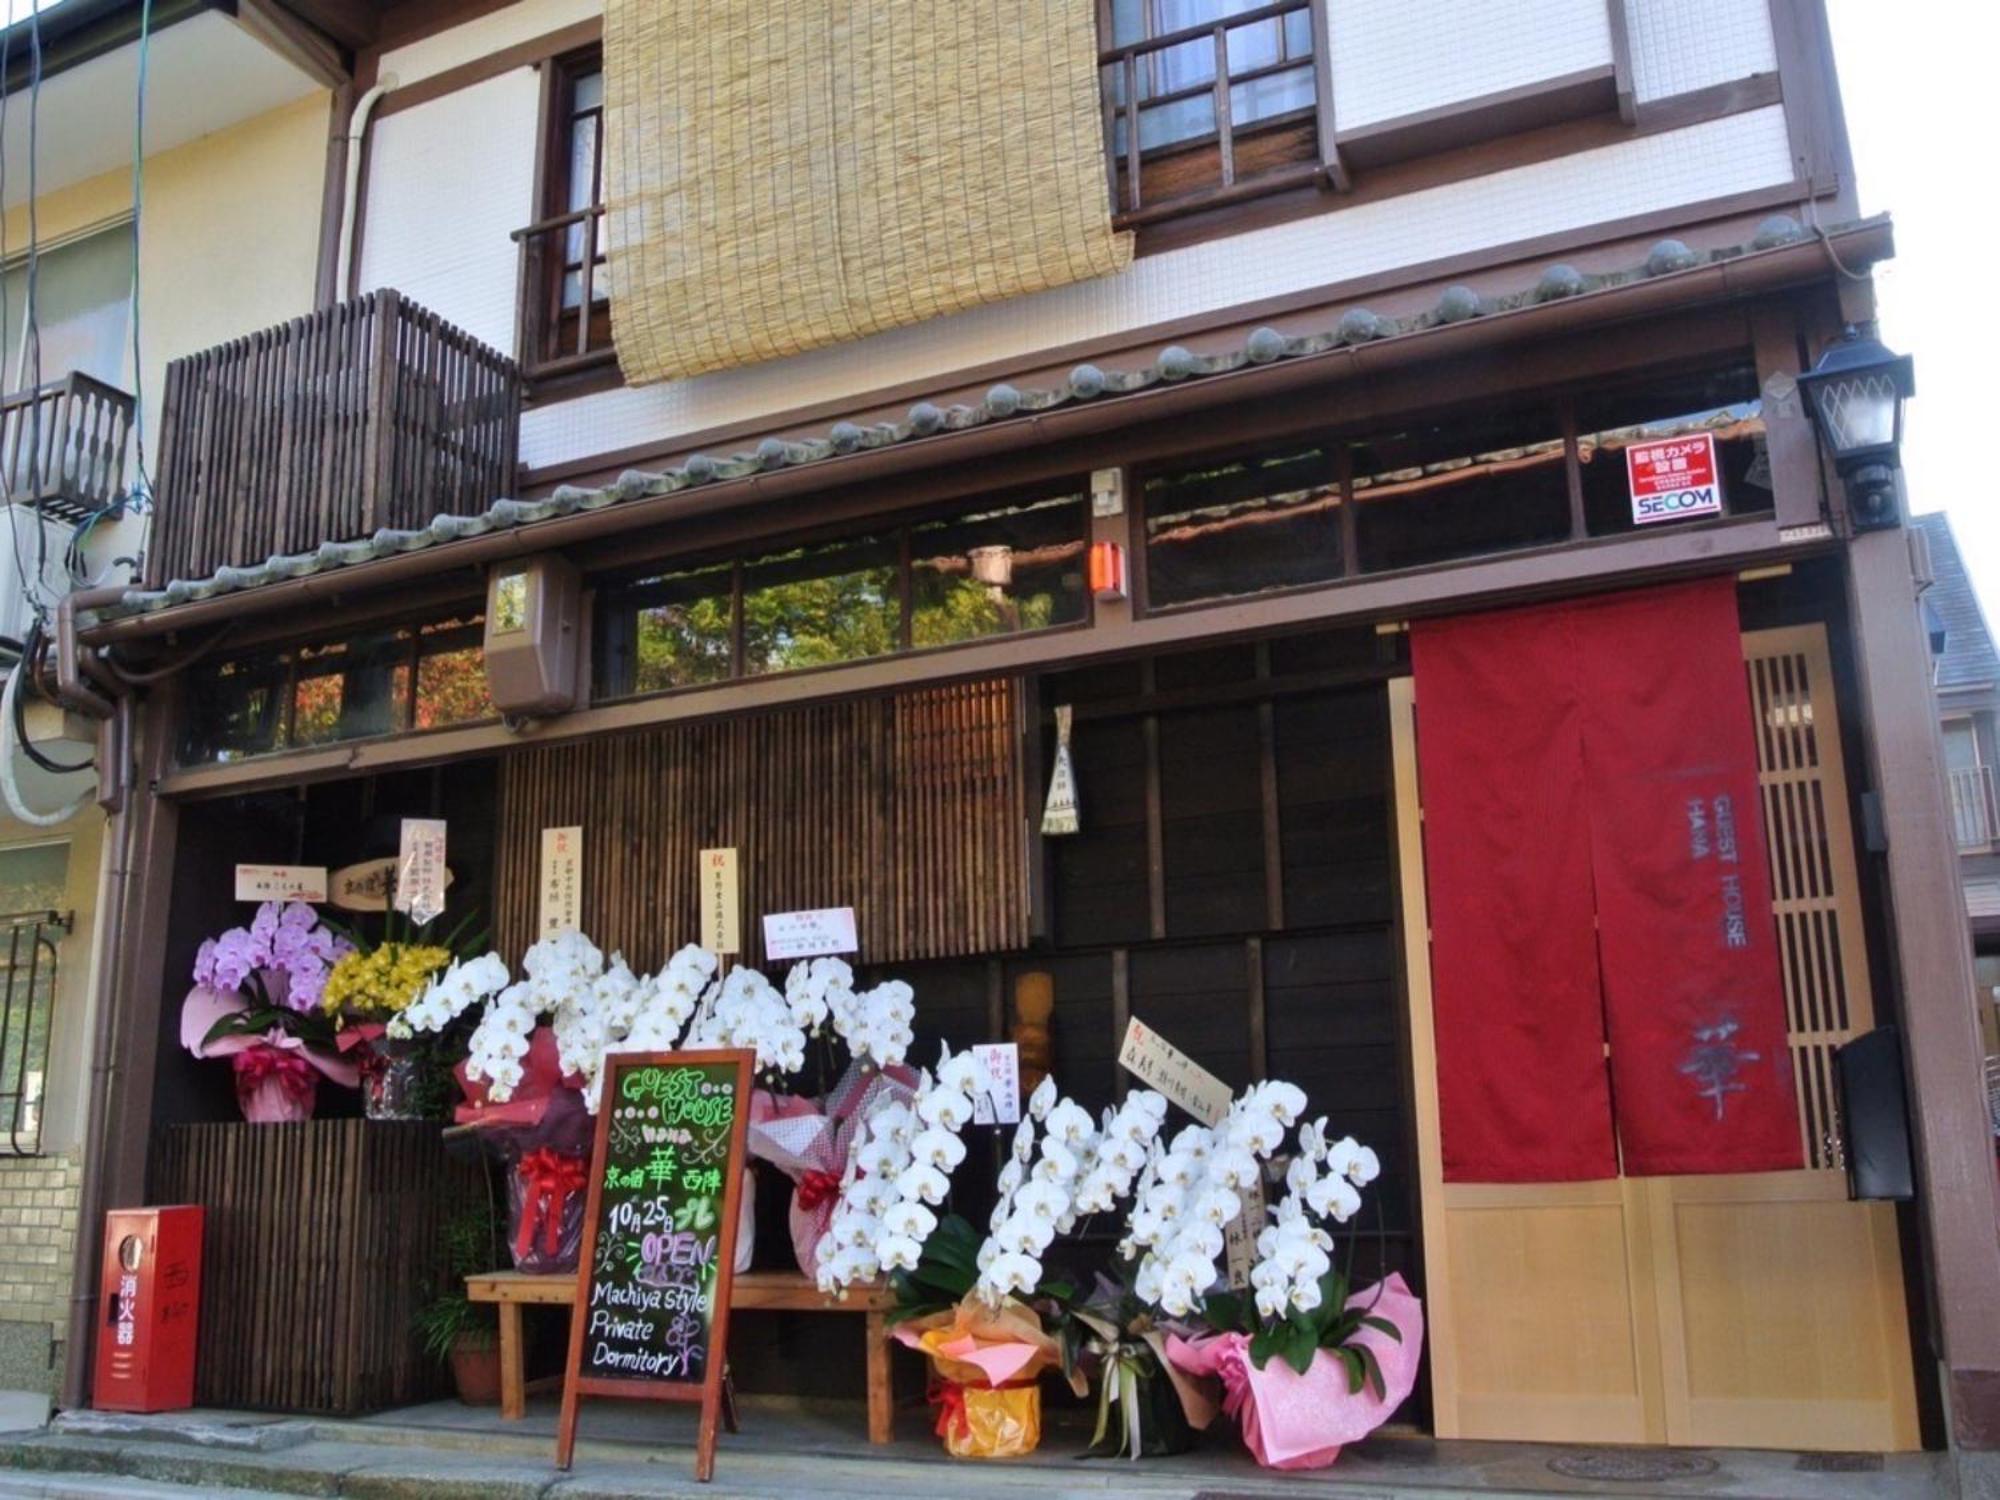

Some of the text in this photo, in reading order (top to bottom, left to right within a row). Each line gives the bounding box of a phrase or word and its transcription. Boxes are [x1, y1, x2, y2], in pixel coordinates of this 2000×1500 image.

[1638, 488, 1713, 514] SECOM
[1688, 799, 1710, 859] HANA
[1713, 798, 1746, 947] GUEST HOUSE
[623, 1068, 705, 1101] GUEST
[662, 1097, 734, 1126] HOUSE
[646, 1146, 678, 1191] 華
[682, 1168, 722, 1195] 西陣
[641, 1232, 716, 1266] OPEN
[117, 1274, 138, 1345] 消火器
[591, 1281, 661, 1314] Machiya
[590, 1310, 654, 1342] Private
[593, 1342, 681, 1375] Dormitory
